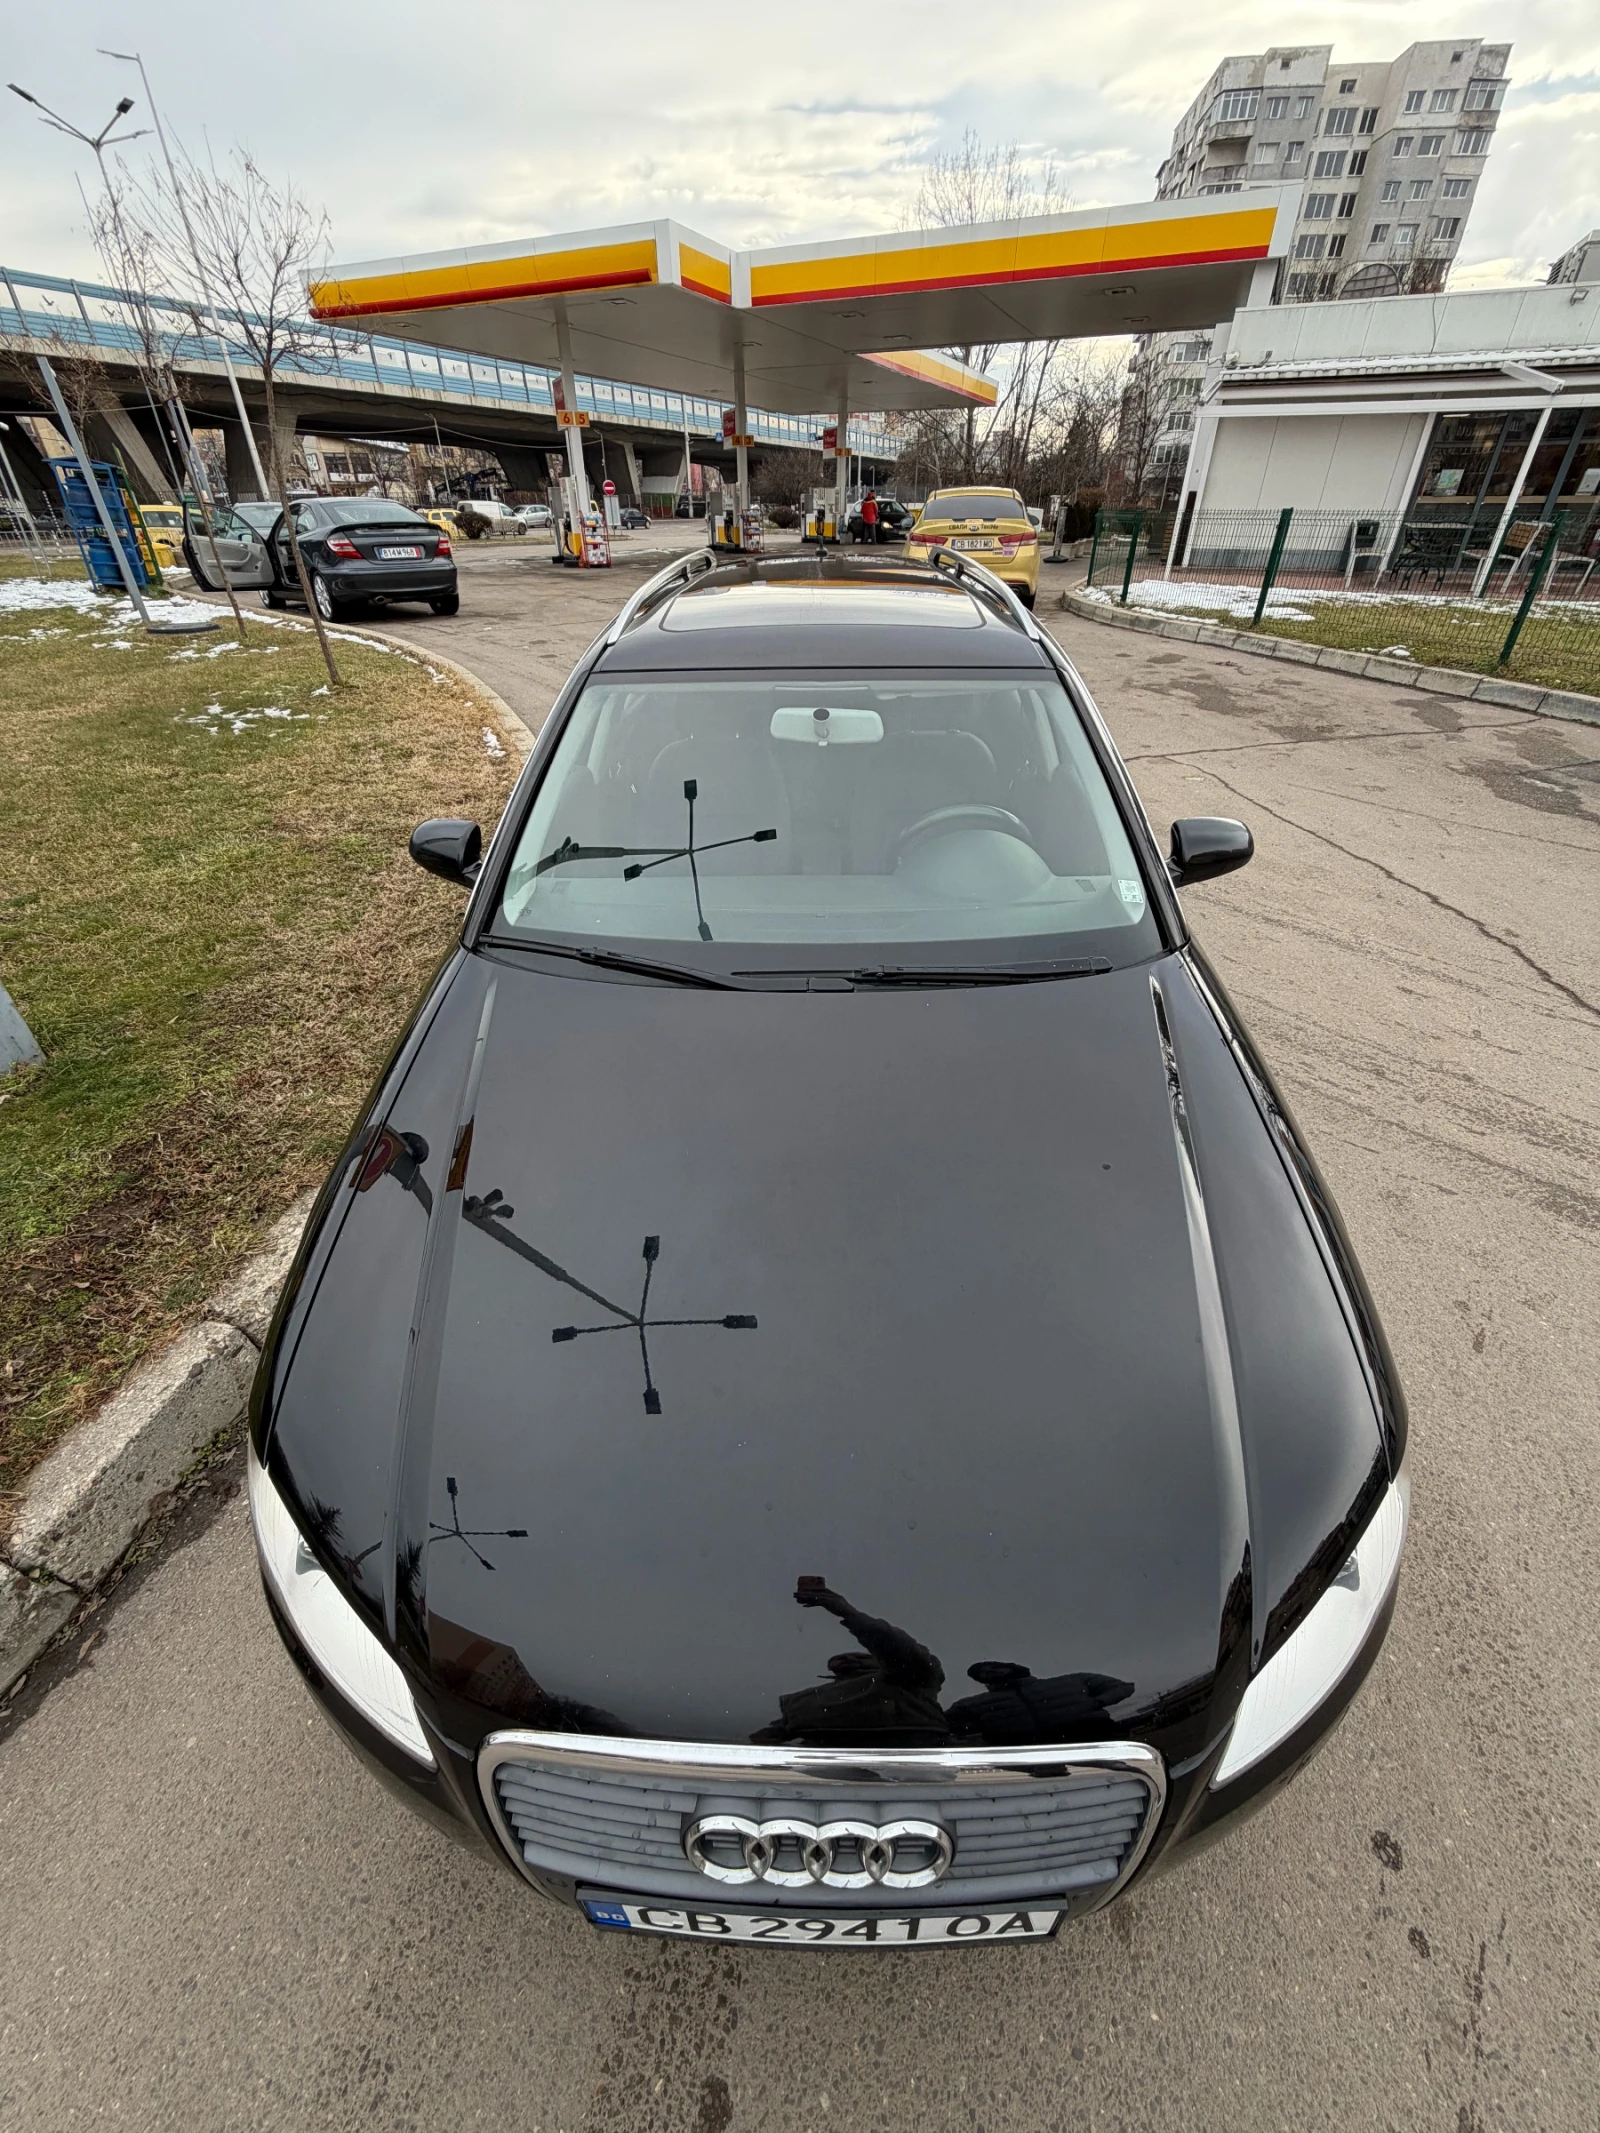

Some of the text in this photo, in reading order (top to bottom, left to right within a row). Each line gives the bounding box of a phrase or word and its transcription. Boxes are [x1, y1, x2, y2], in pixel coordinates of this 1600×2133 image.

[563, 413, 586, 425] 6 5
[735, 436, 752, 446] 4 3
[956, 540, 966, 549] CB
[967, 540, 982, 548] 1821
[596, 1907, 1035, 1941] BG CB 2941 OA
